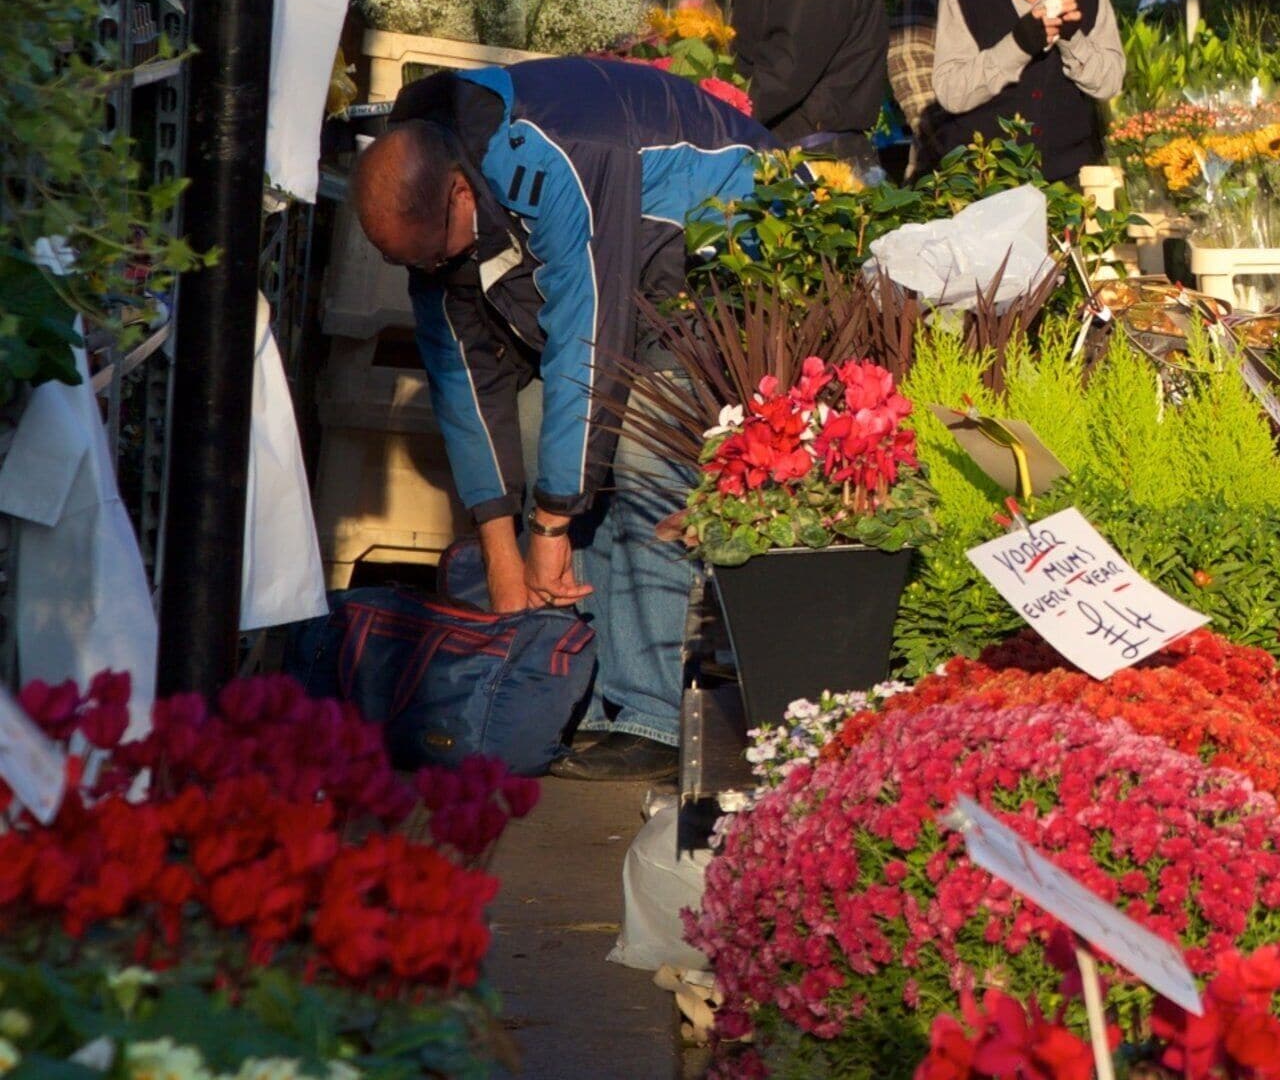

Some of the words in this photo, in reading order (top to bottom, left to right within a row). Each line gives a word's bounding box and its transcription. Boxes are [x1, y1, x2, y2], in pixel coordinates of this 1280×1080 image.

[992, 529, 1066, 585] YODER
[1042, 546, 1096, 582] MUMS
[1022, 586, 1072, 619] EVERY
[1081, 560, 1124, 588] YEAR
[1077, 600, 1166, 660] £4
